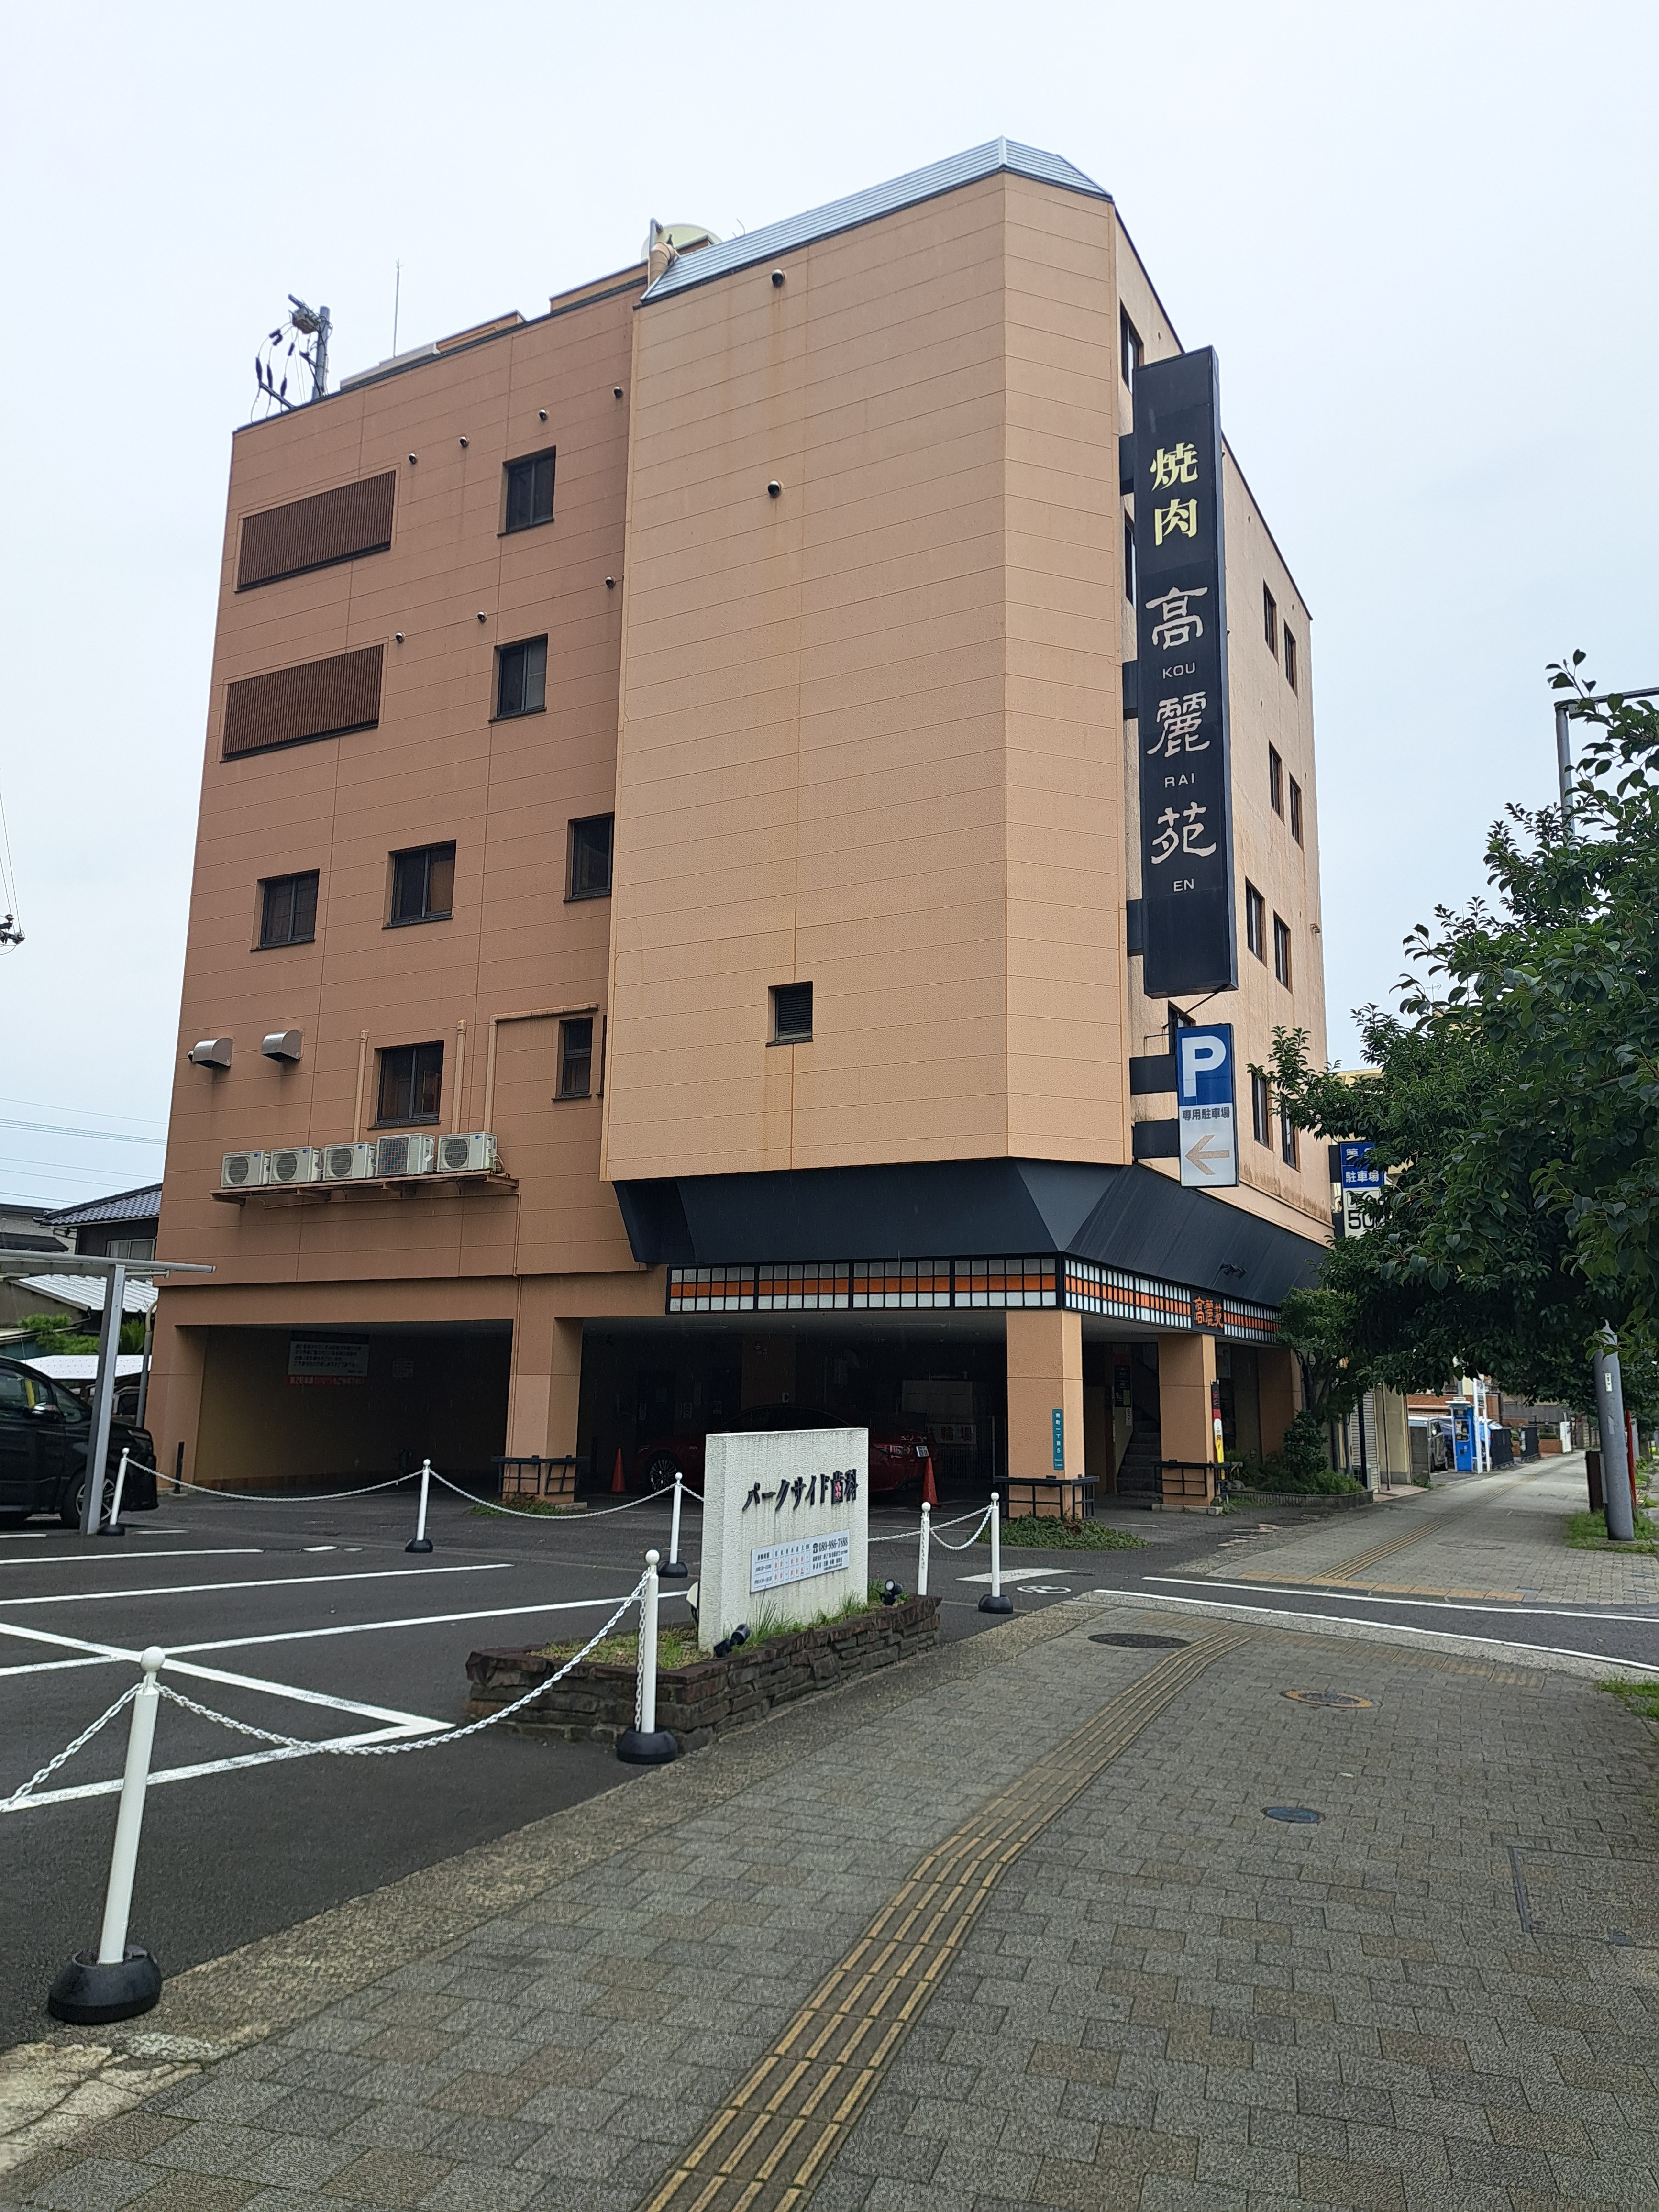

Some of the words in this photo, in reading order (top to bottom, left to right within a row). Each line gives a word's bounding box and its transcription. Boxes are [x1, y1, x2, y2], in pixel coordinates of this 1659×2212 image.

[1149, 442, 1199, 546] 焼肉
[1162, 661, 1196, 679] KOU
[1164, 772, 1195, 788] RAI
[1172, 878, 1194, 892] EN
[1182, 1035, 1227, 1098] P
[1182, 1106, 1230, 1121] 専用駐車場
[1345, 1170, 1380, 1183] 駐車場
[1193, 1296, 1224, 1328] 高麗苑
[742, 1468, 859, 1512] パークサイド歯科
